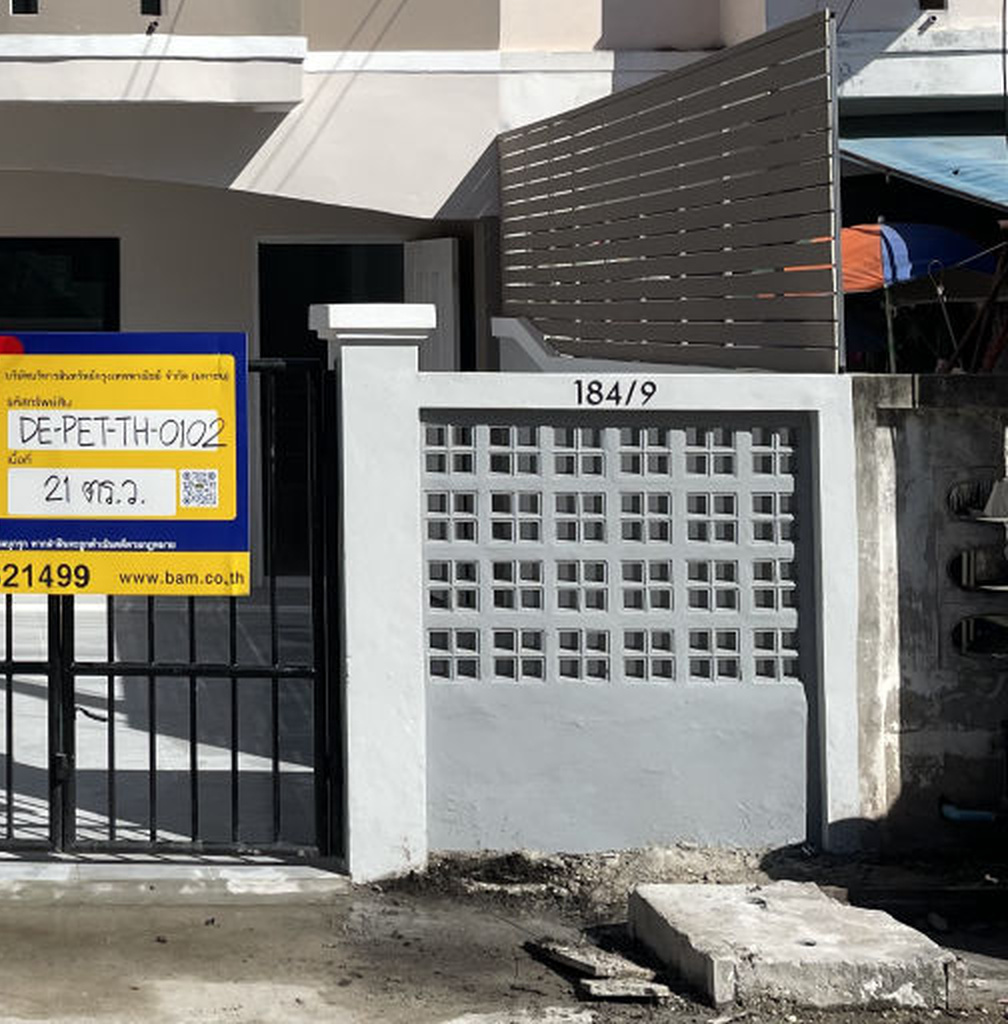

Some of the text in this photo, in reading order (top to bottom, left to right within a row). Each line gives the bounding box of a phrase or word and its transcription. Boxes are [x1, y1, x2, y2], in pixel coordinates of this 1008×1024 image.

[574, 379, 657, 406] 184/9
[19, 415, 227, 448] DE-PET-TH-0102
[44, 475, 71, 503] 21
[119, 570, 245, 586] www.bam.co.th
